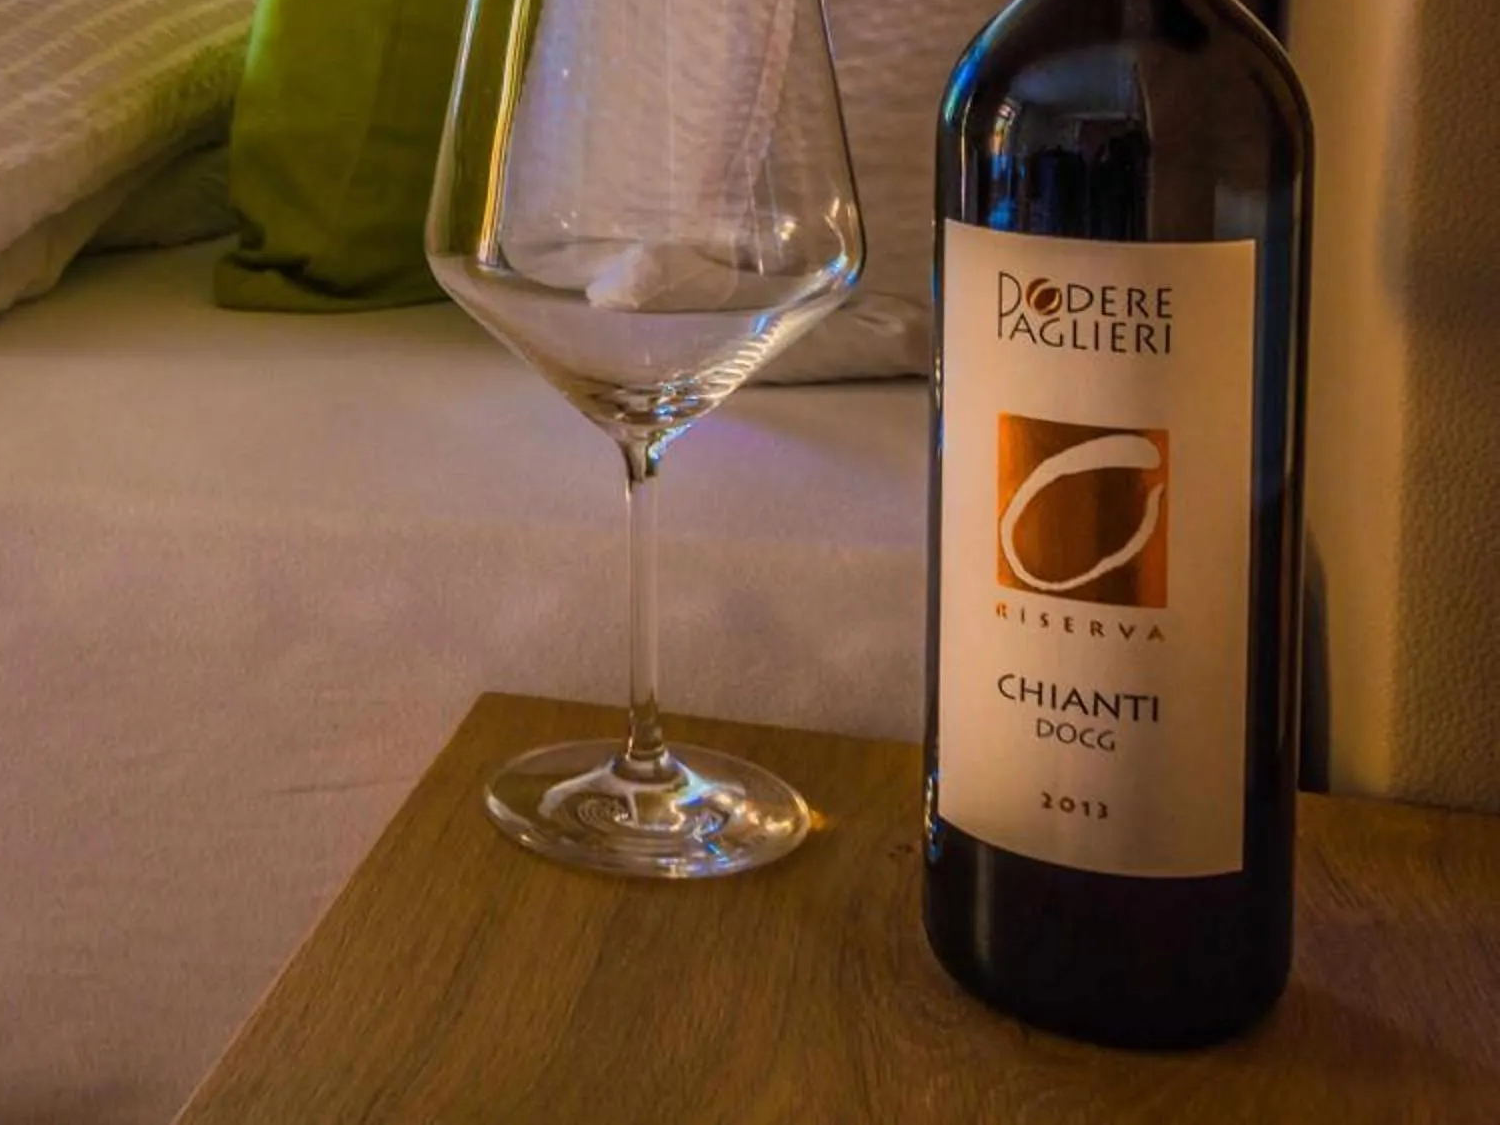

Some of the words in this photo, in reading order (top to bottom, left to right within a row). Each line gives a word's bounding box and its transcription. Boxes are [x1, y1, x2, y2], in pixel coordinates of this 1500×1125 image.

[998, 271, 1174, 320] PODERE
[996, 602, 1166, 643] RISERVA
[997, 674, 1160, 723] CHIANTI
[1036, 718, 1116, 753] DOCG
[1041, 792, 1109, 819] 2013
